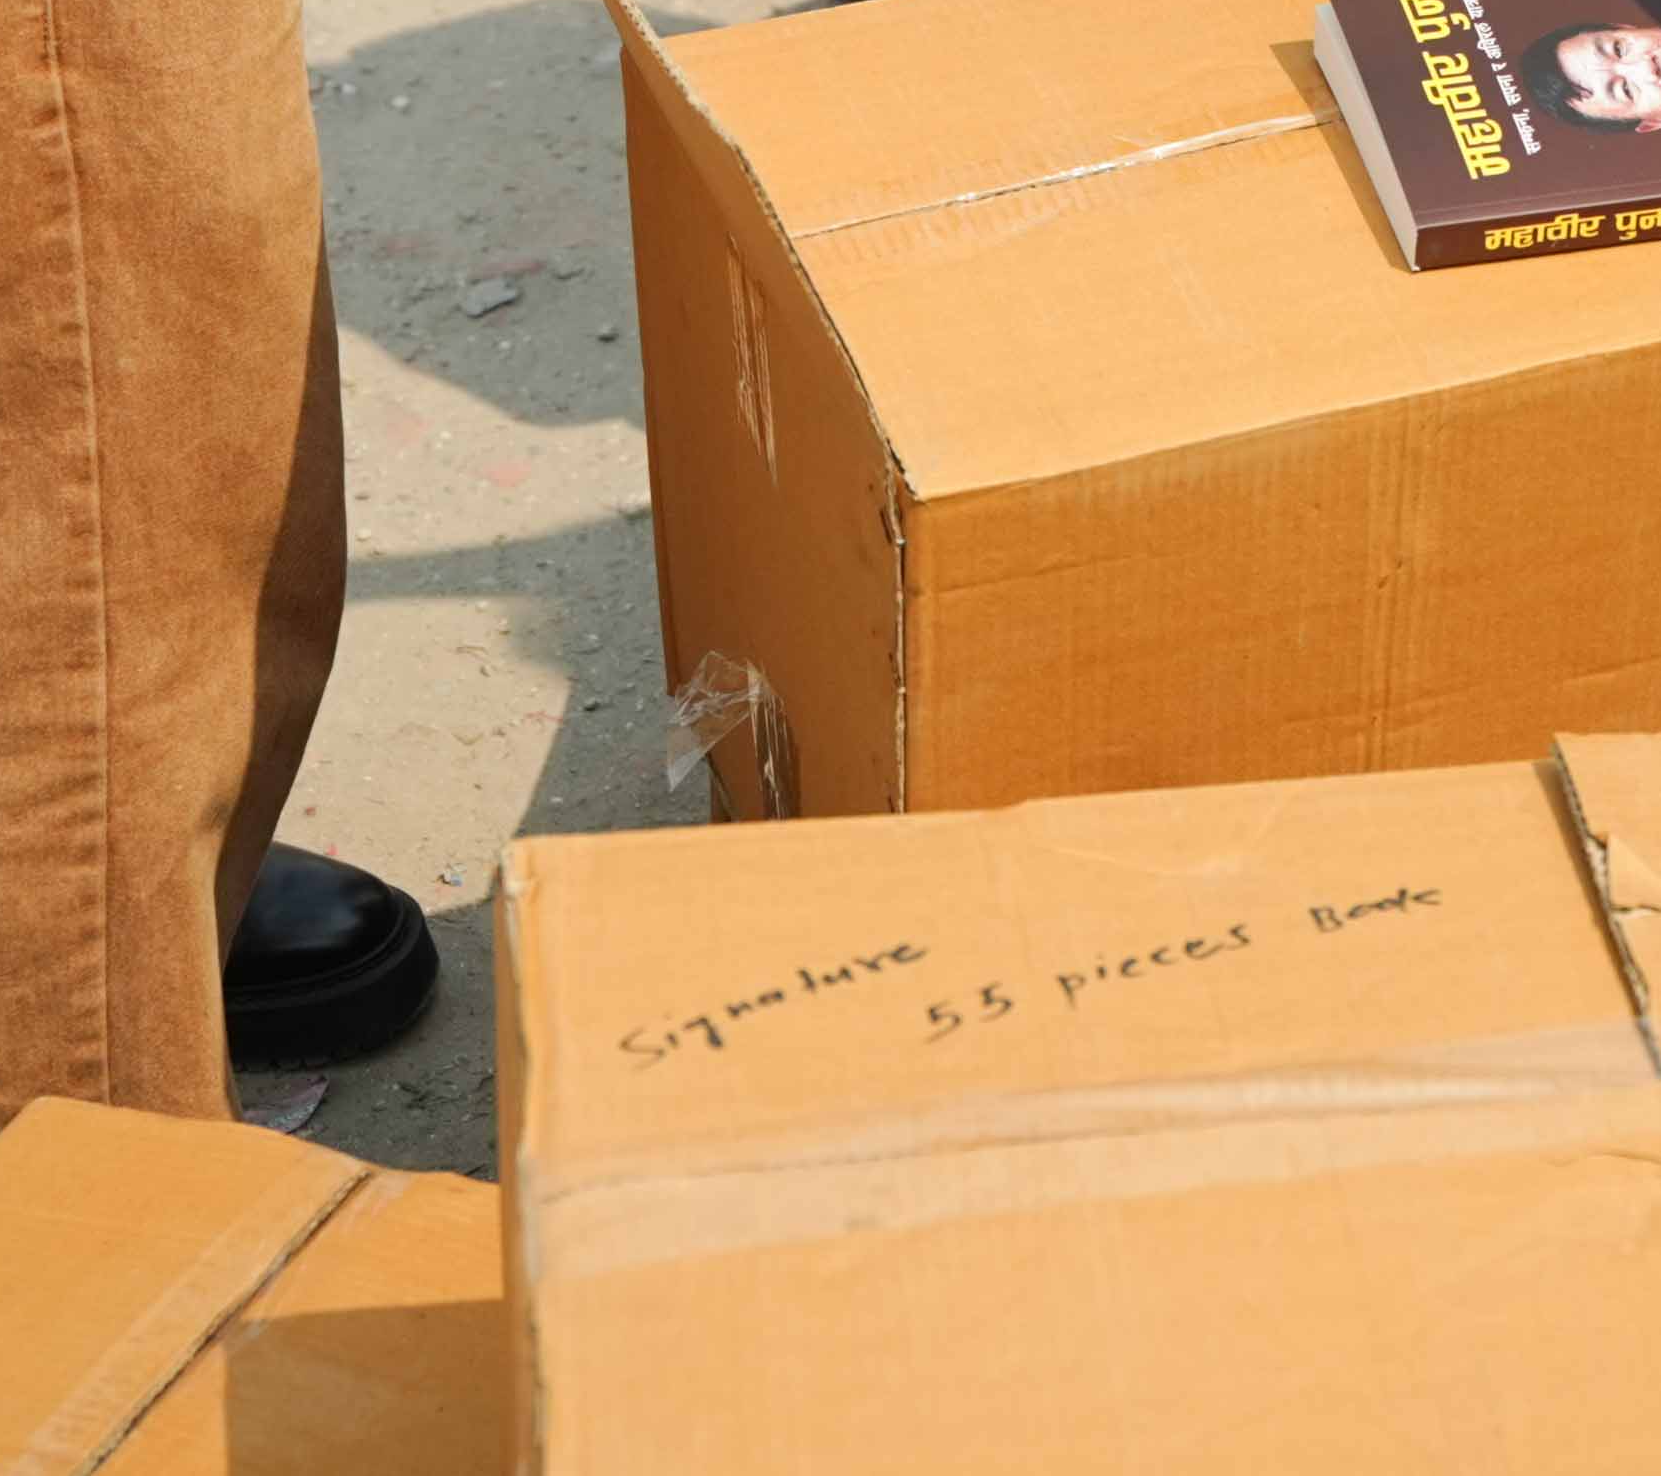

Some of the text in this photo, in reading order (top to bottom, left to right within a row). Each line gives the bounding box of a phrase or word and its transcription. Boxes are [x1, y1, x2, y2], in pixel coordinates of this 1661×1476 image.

[1422, 51, 1511, 179] महावीर
[1484, 212, 1605, 250] महावीर
[618, 939, 927, 1069] Signature
[924, 885, 1444, 1043] 55 pieces Book
